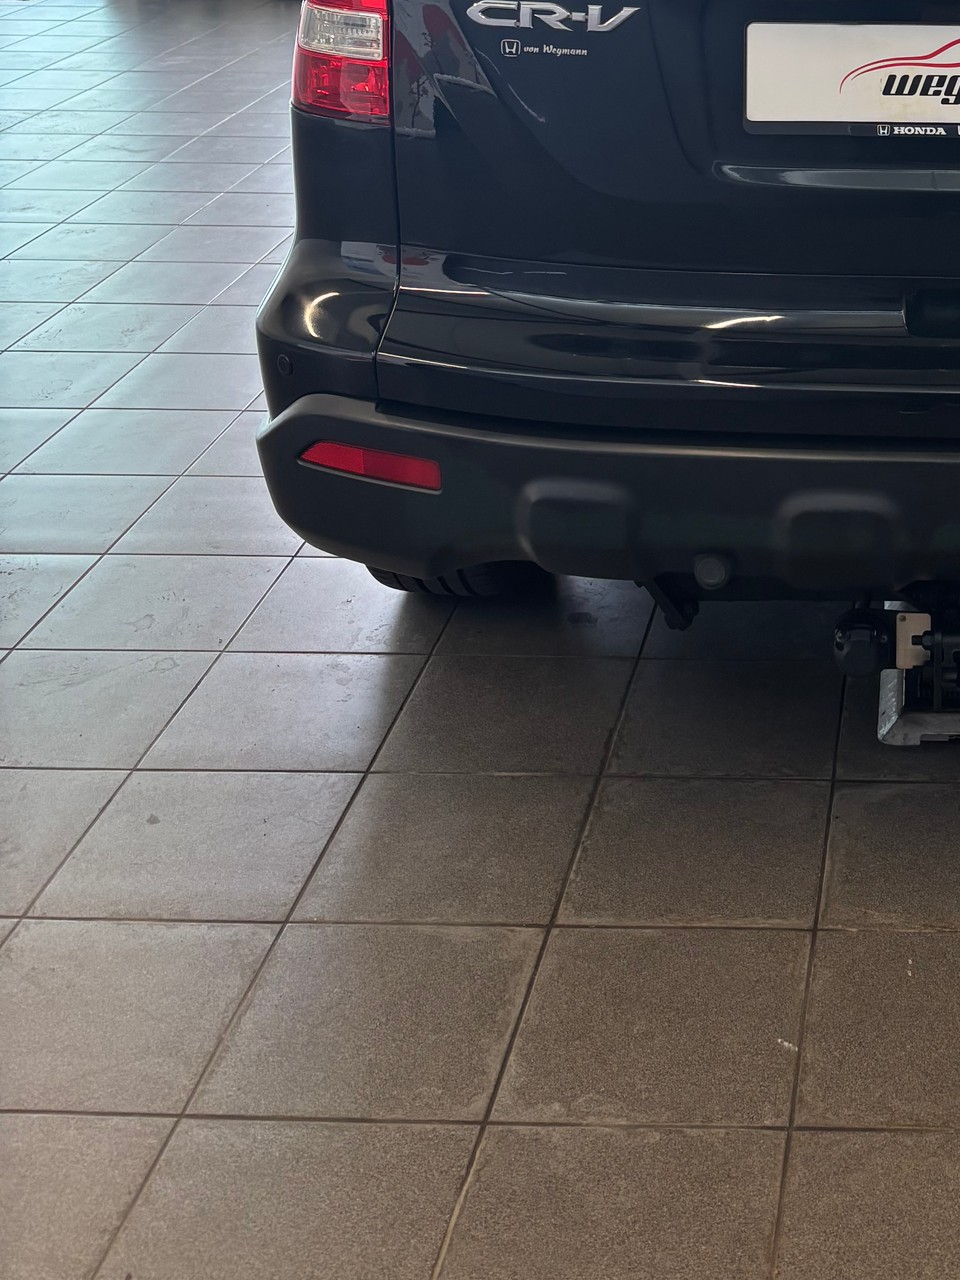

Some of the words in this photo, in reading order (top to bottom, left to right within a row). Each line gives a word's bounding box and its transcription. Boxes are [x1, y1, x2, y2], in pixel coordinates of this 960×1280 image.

[466, 0, 641, 32] CR-V
[543, 44, 588, 57] Wegmann
[893, 126, 947, 136] HONDA
